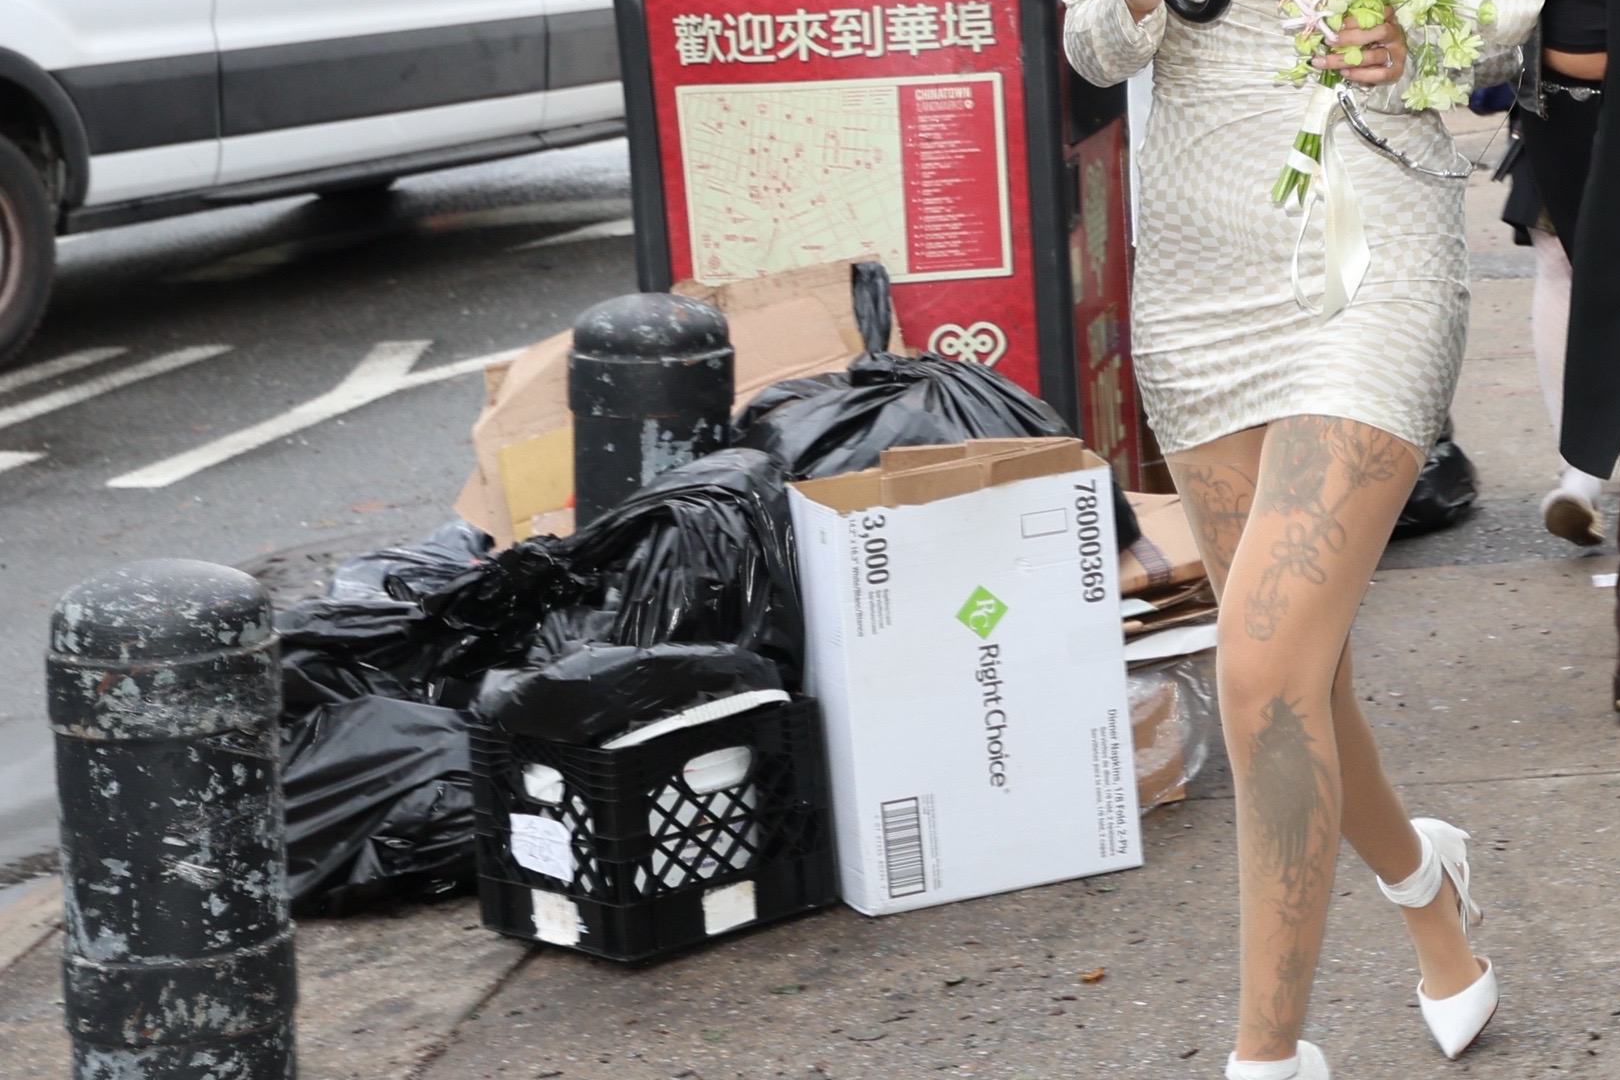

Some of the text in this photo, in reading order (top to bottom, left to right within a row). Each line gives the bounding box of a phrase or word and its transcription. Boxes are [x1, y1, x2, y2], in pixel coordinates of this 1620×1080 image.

[672, 1, 996, 66] 歡迎來到華埠
[915, 86, 971, 101] CHINATOWN
[858, 514, 890, 585] 3,000
[1073, 479, 1106, 604] 78000369
[968, 597, 997, 630] RC
[975, 643, 1010, 788] Right Choice
[1107, 708, 1118, 740] Dinner
[1114, 787, 1124, 803] 1/8
[1117, 829, 1128, 855] 2-Ply
